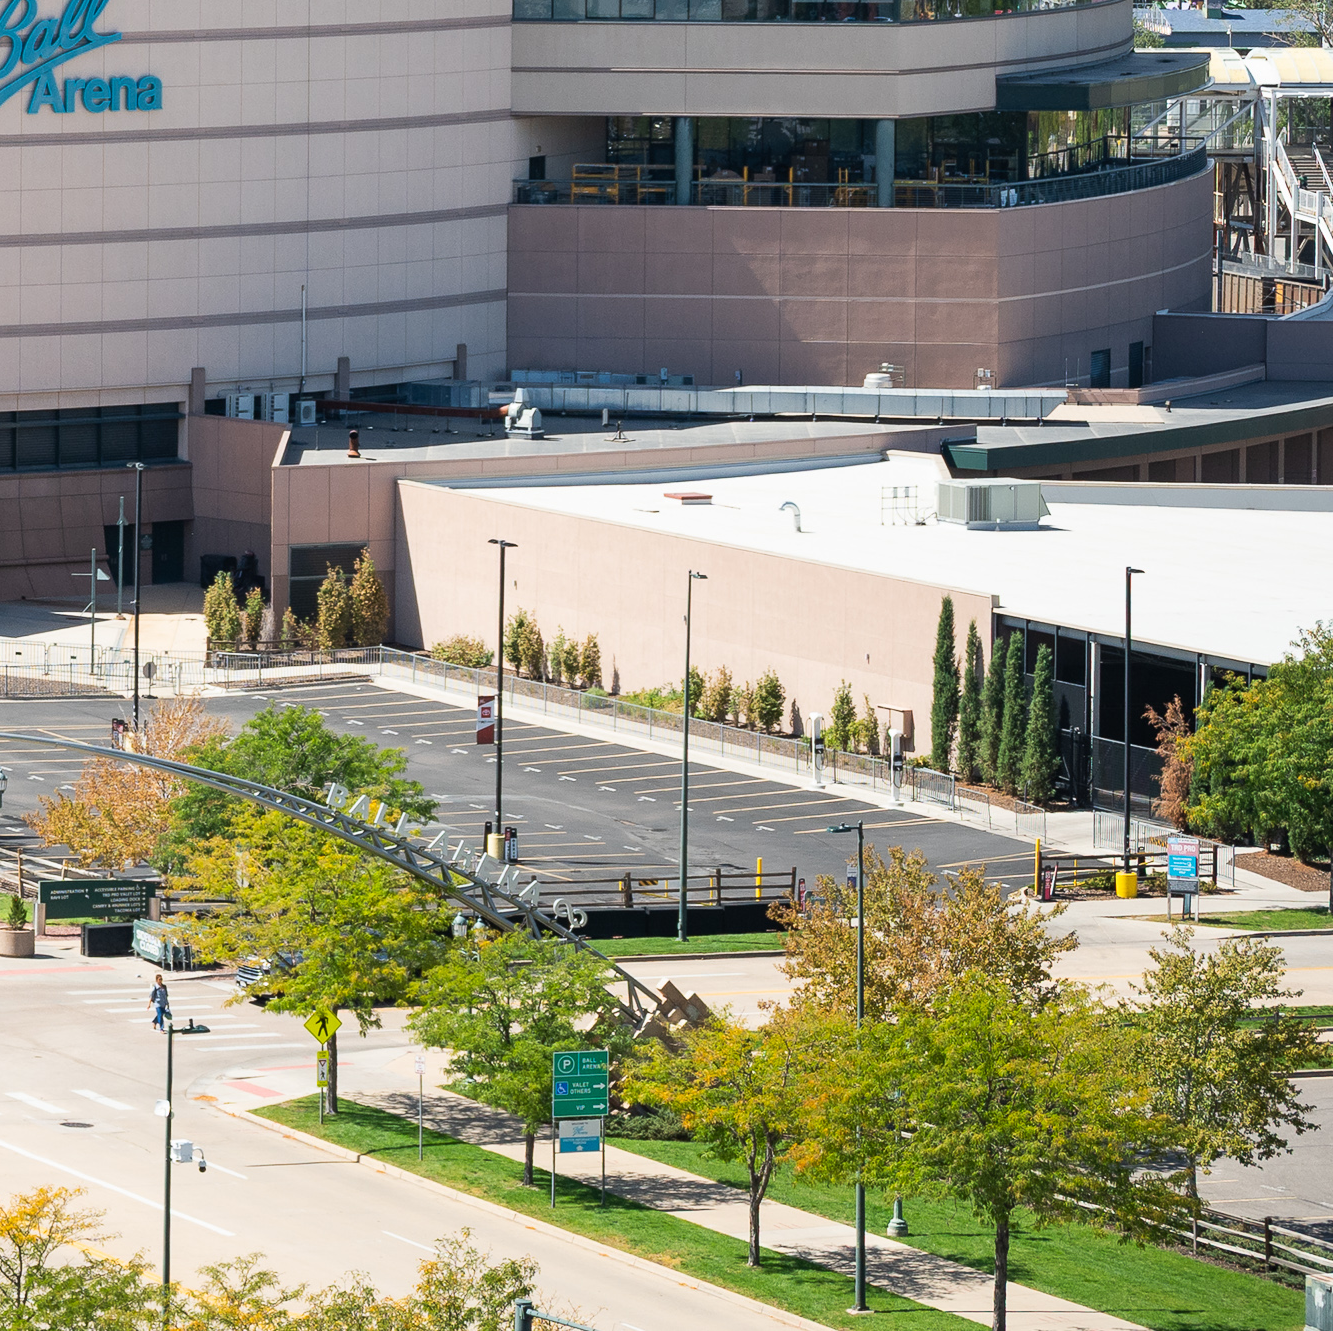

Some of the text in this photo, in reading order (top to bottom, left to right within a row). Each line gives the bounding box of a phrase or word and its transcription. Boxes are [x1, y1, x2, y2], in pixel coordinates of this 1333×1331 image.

[26, 69, 163, 114] Arena
[325, 781, 541, 909] BALL ARENA
